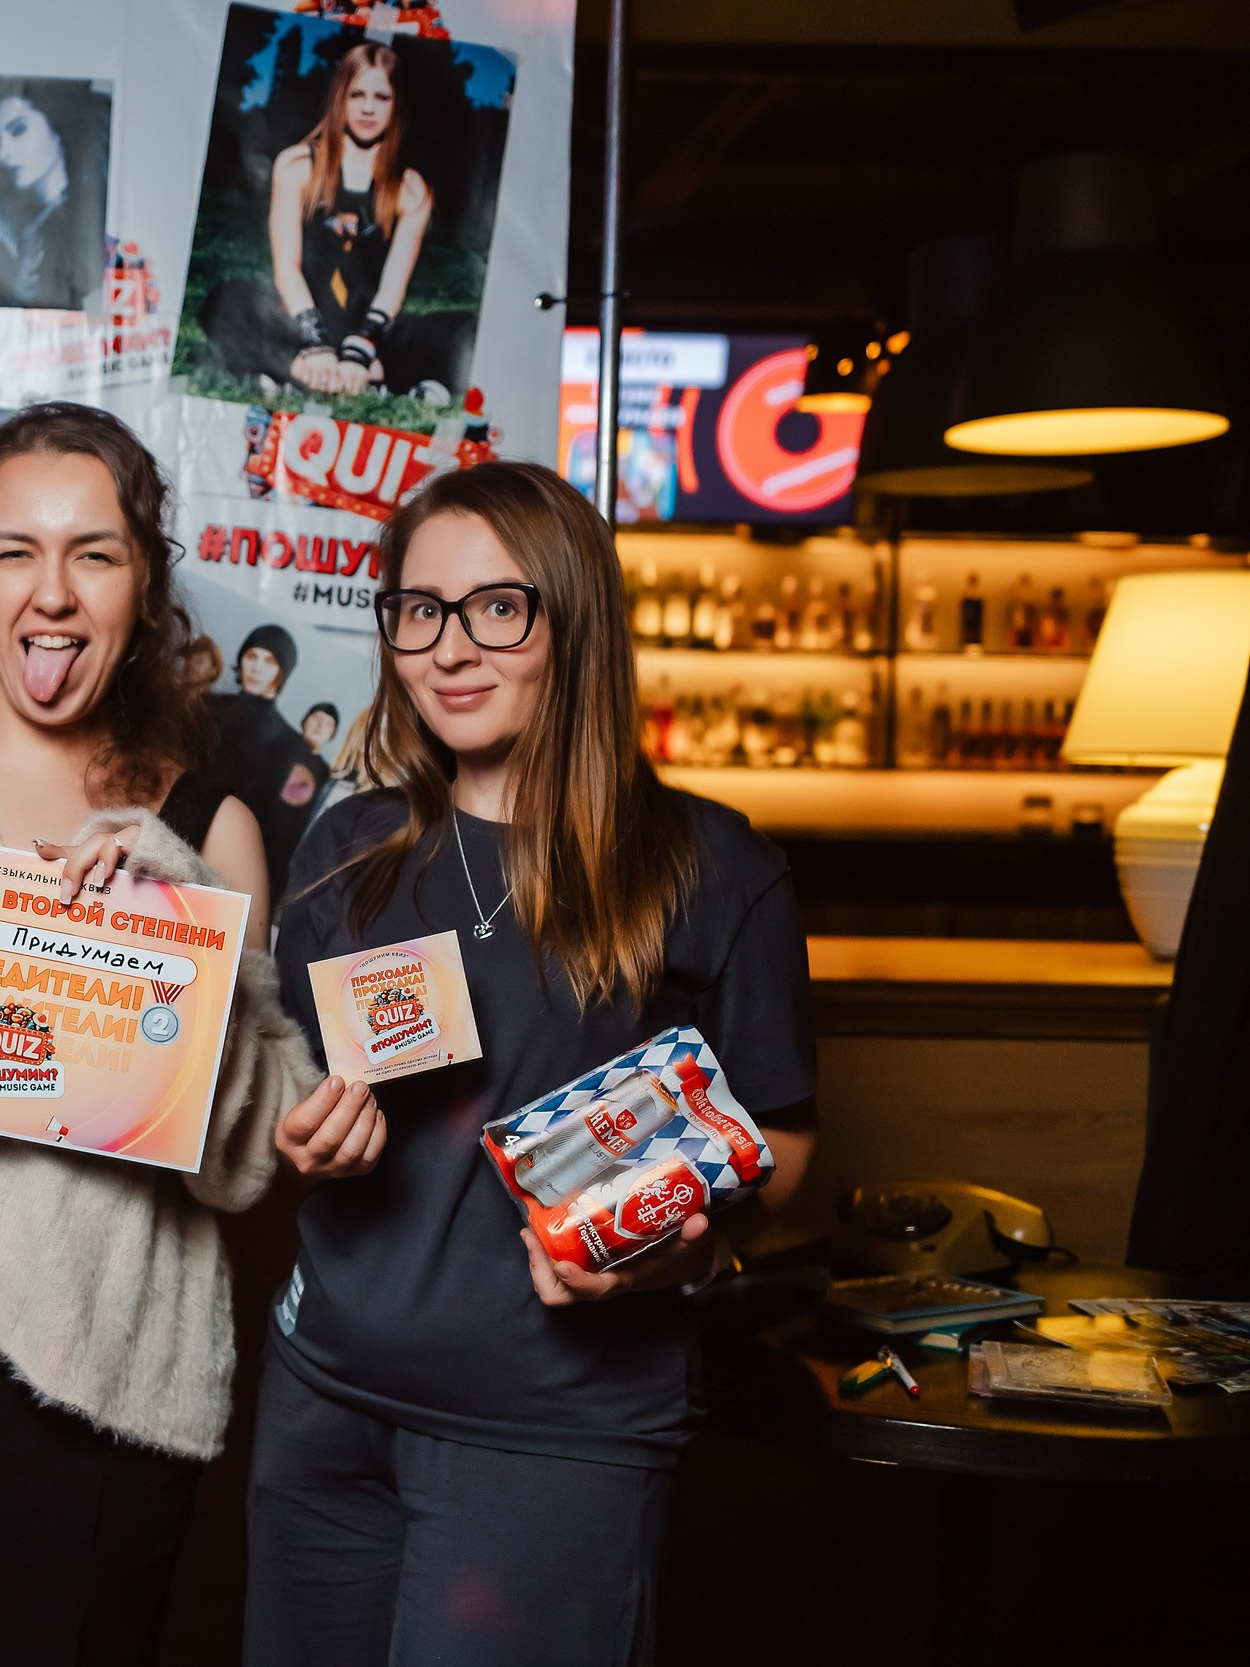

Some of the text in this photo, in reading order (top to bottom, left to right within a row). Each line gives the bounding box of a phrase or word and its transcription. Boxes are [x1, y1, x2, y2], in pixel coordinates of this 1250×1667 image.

[197, 524, 381, 579] #ПОШУ
[294, 584, 374, 608] #MUS
[2, 889, 105, 927] ВТОРОЙ
[110, 911, 226, 950] СТЕПЕНИ
[12, 927, 164, 975] Придумаем
[350, 962, 423, 988] ПРОХОДКА!
[353, 973, 425, 998] ПРОХОДКА!
[152, 1012, 170, 1037] 2
[375, 1004, 416, 1026] QUIZ
[371, 1018, 433, 1053] #ПОШУМИМ?
[394, 1028, 435, 1051] #MUSIC GAME
[30, 1083, 56, 1092] GAME
[691, 1088, 754, 1150] Oktoberfest
[504, 1135, 521, 1147] 4
